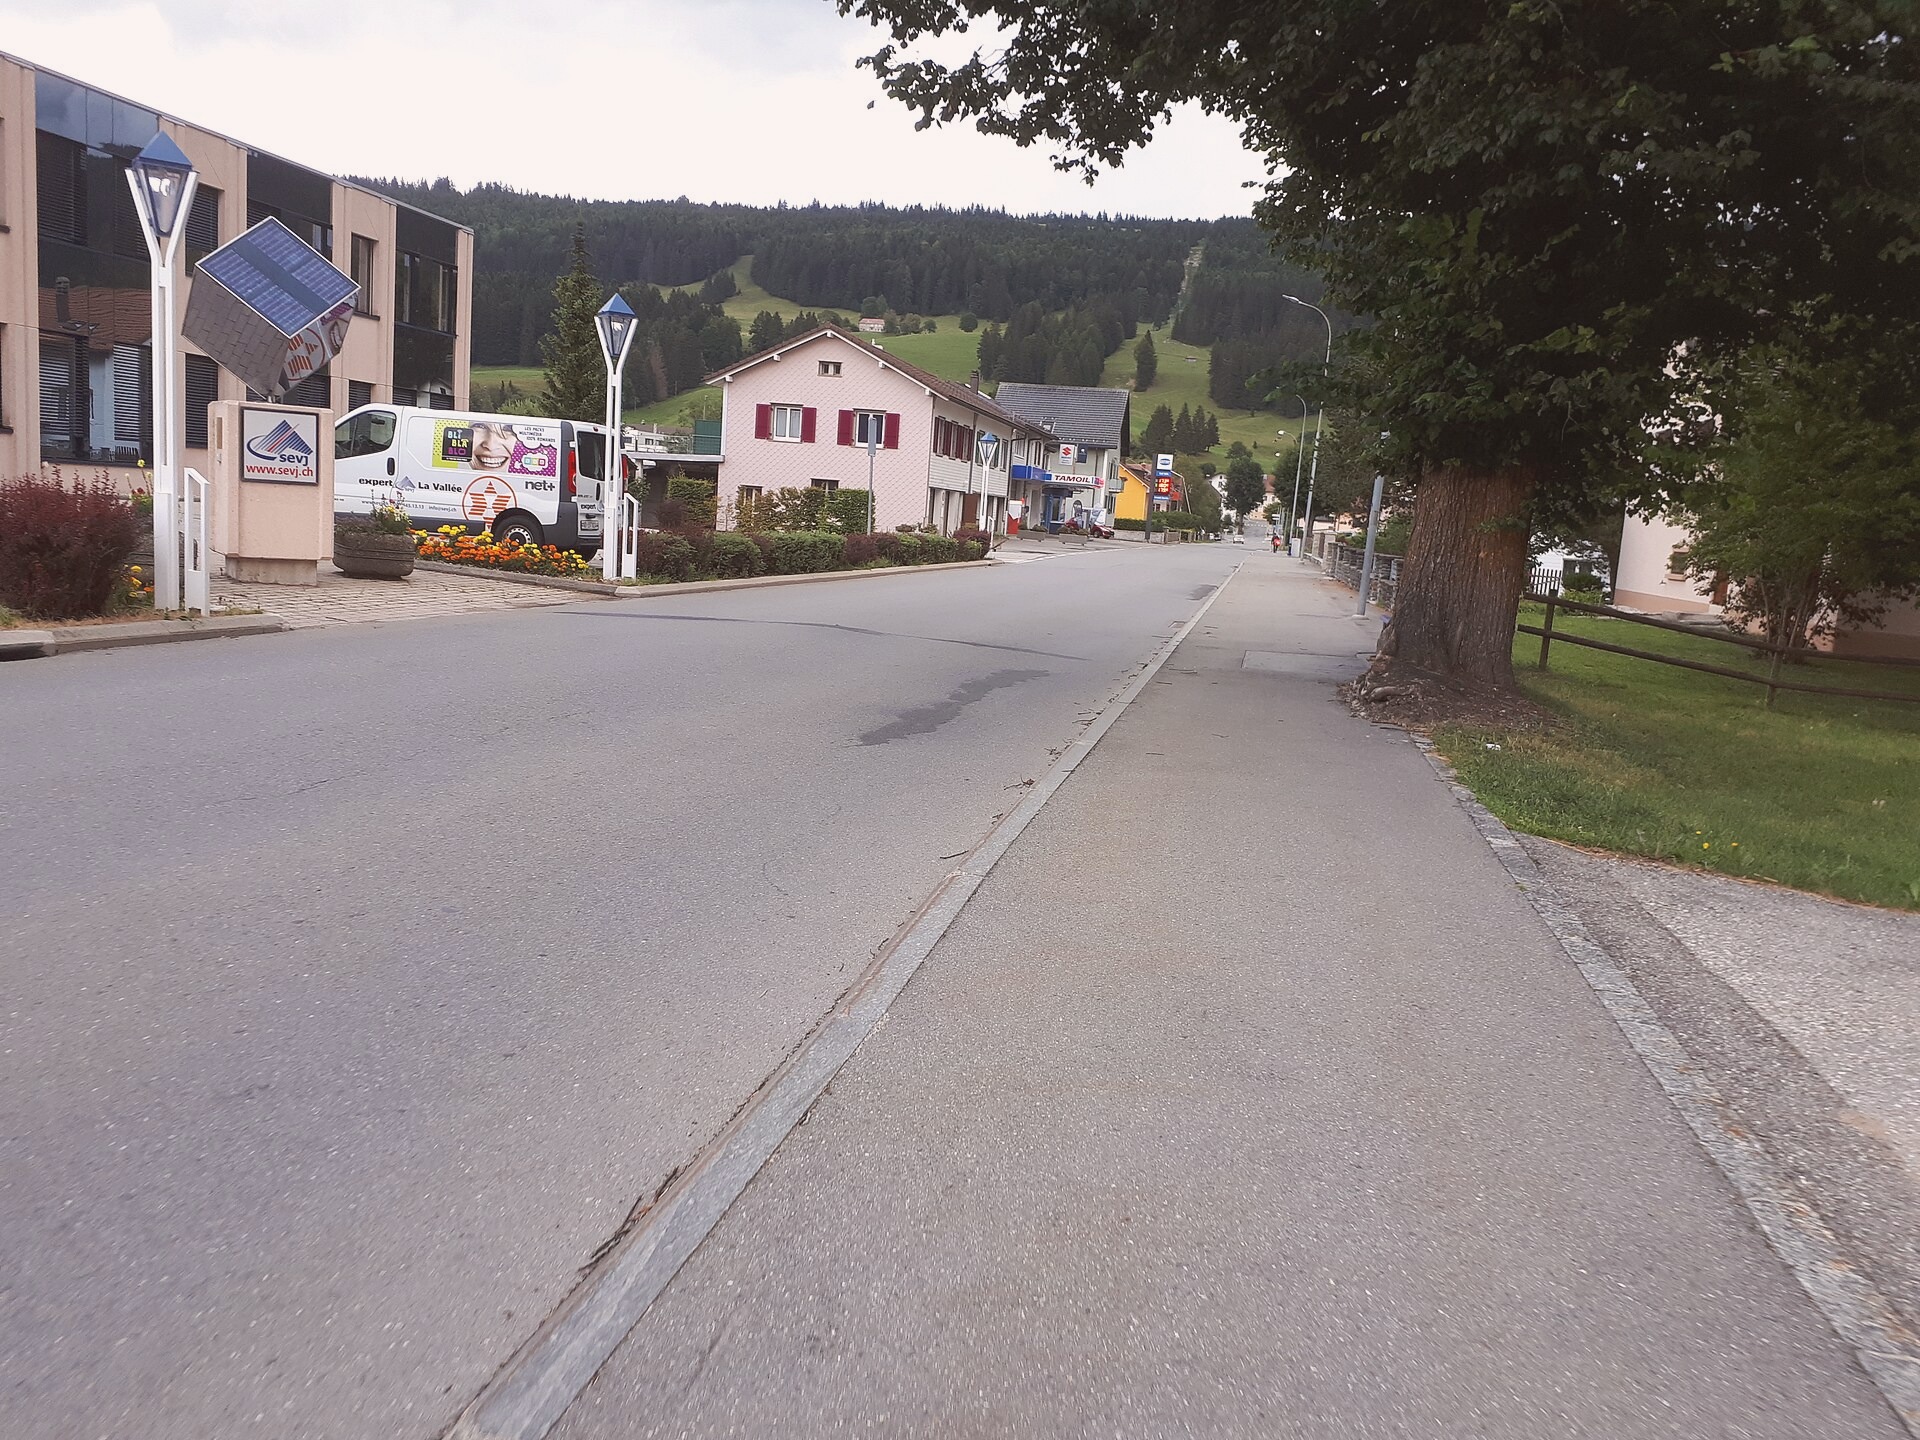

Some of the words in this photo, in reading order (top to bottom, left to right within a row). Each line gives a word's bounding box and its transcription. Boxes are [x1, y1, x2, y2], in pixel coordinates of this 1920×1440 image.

[451, 439, 469, 448] BLA
[448, 447, 466, 455] BLO
[279, 453, 309, 467] sevj
[246, 465, 314, 478] www.sevj.ch
[359, 478, 393, 486] expert
[1055, 475, 1090, 483] TAMOIL
[418, 481, 430, 490] La
[433, 483, 462, 492] Vallée
[525, 480, 556, 491] net+
